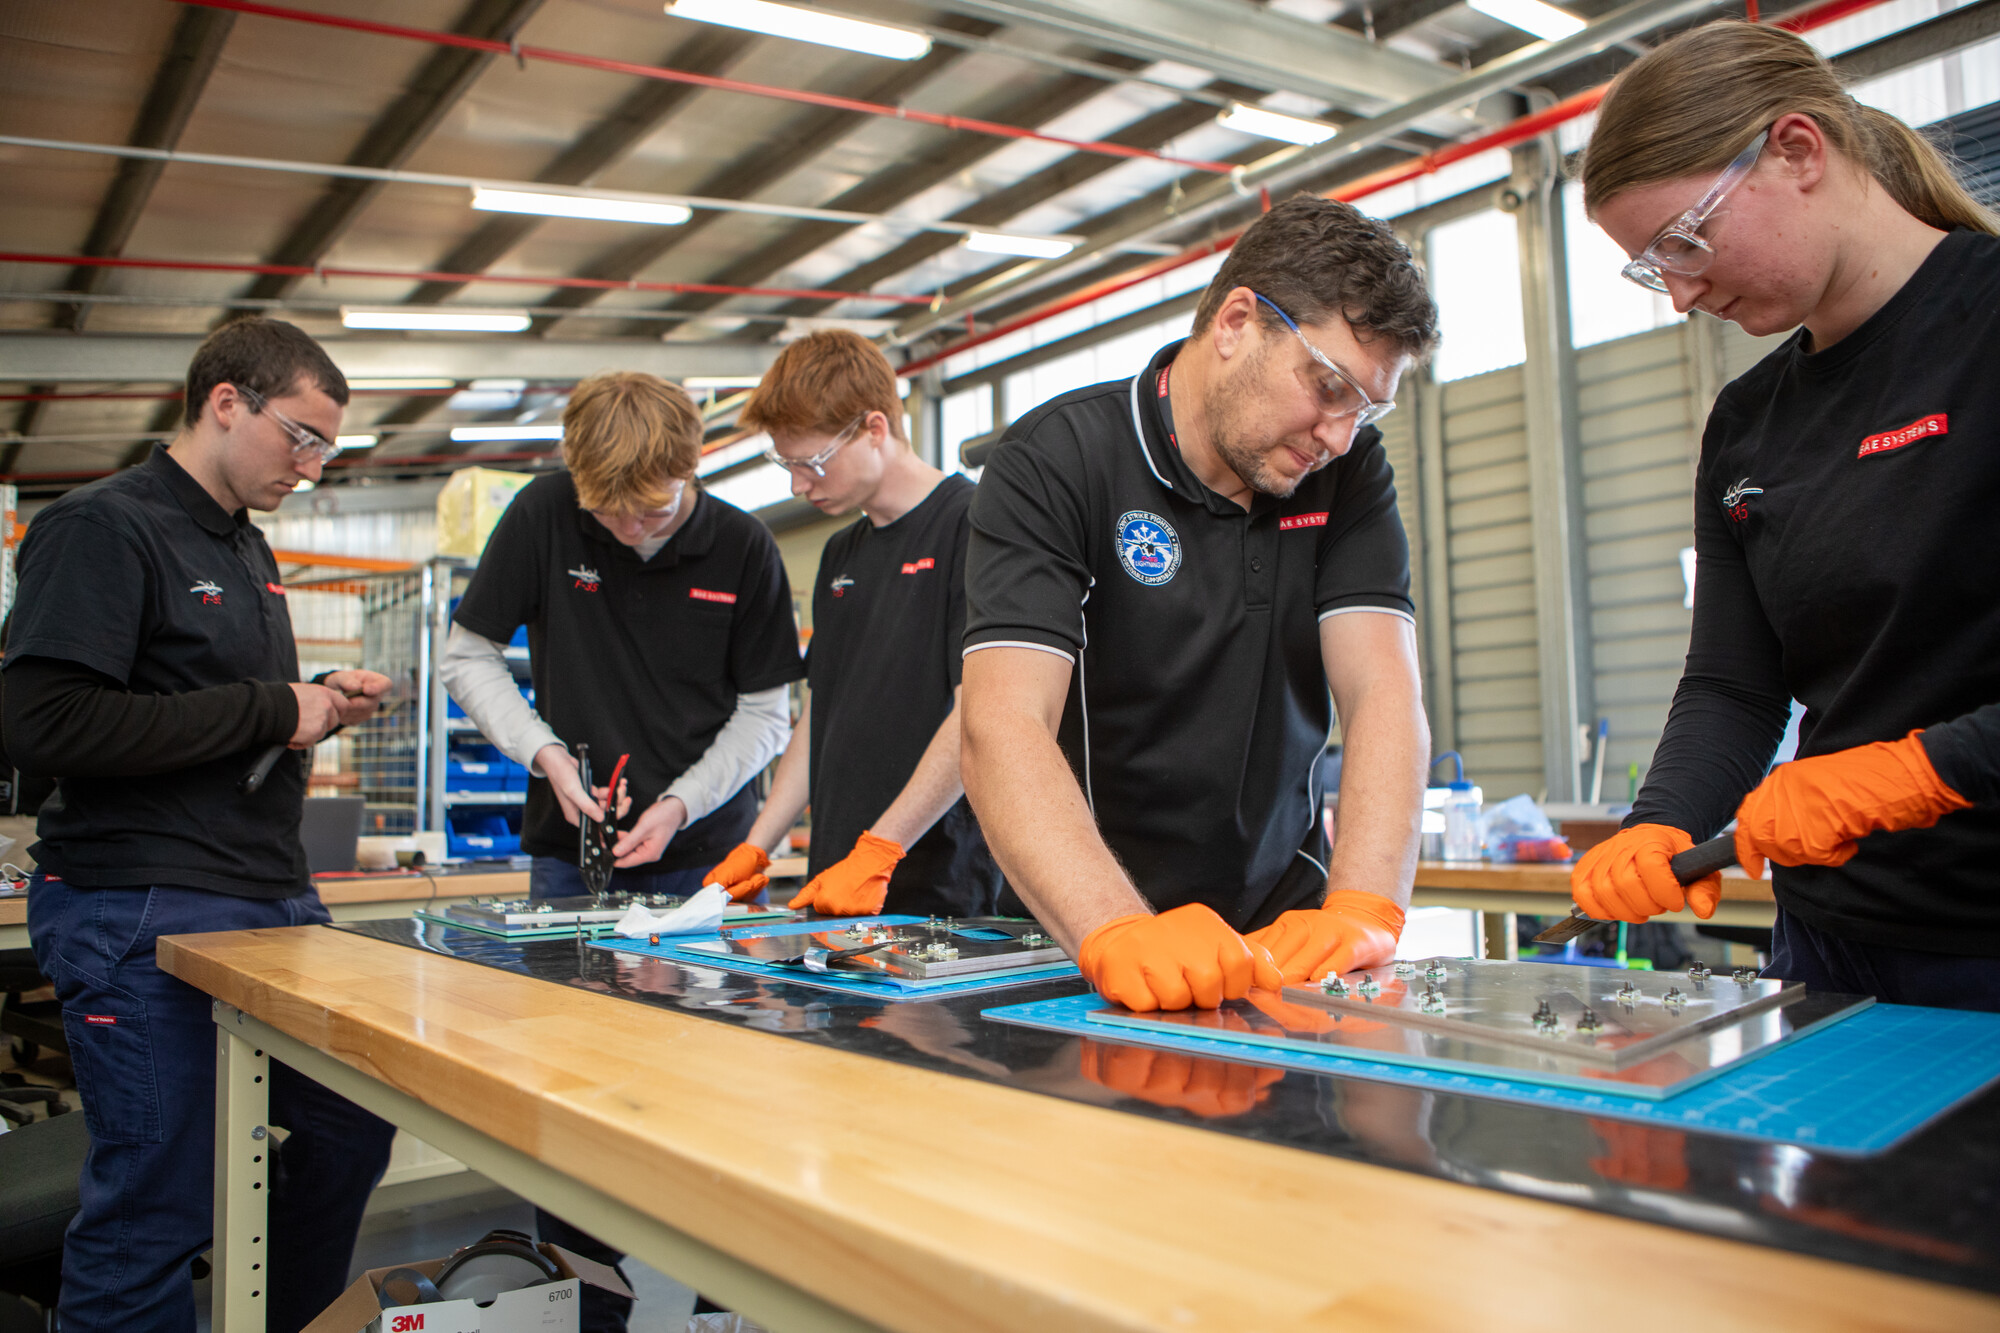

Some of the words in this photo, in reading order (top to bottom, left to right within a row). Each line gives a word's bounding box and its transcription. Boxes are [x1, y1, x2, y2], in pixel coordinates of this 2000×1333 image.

[1859, 440, 1880, 454] BAE
[1882, 420, 1939, 448] SYSTEMS
[1127, 512, 1149, 520] STRIKE
[1150, 514, 1175, 537] FIGHTER
[1280, 520, 1293, 528] AE
[1296, 516, 1327, 526] SYSTE
[548, 1288, 573, 1303] 6700
[391, 1313, 425, 1333] 3M
